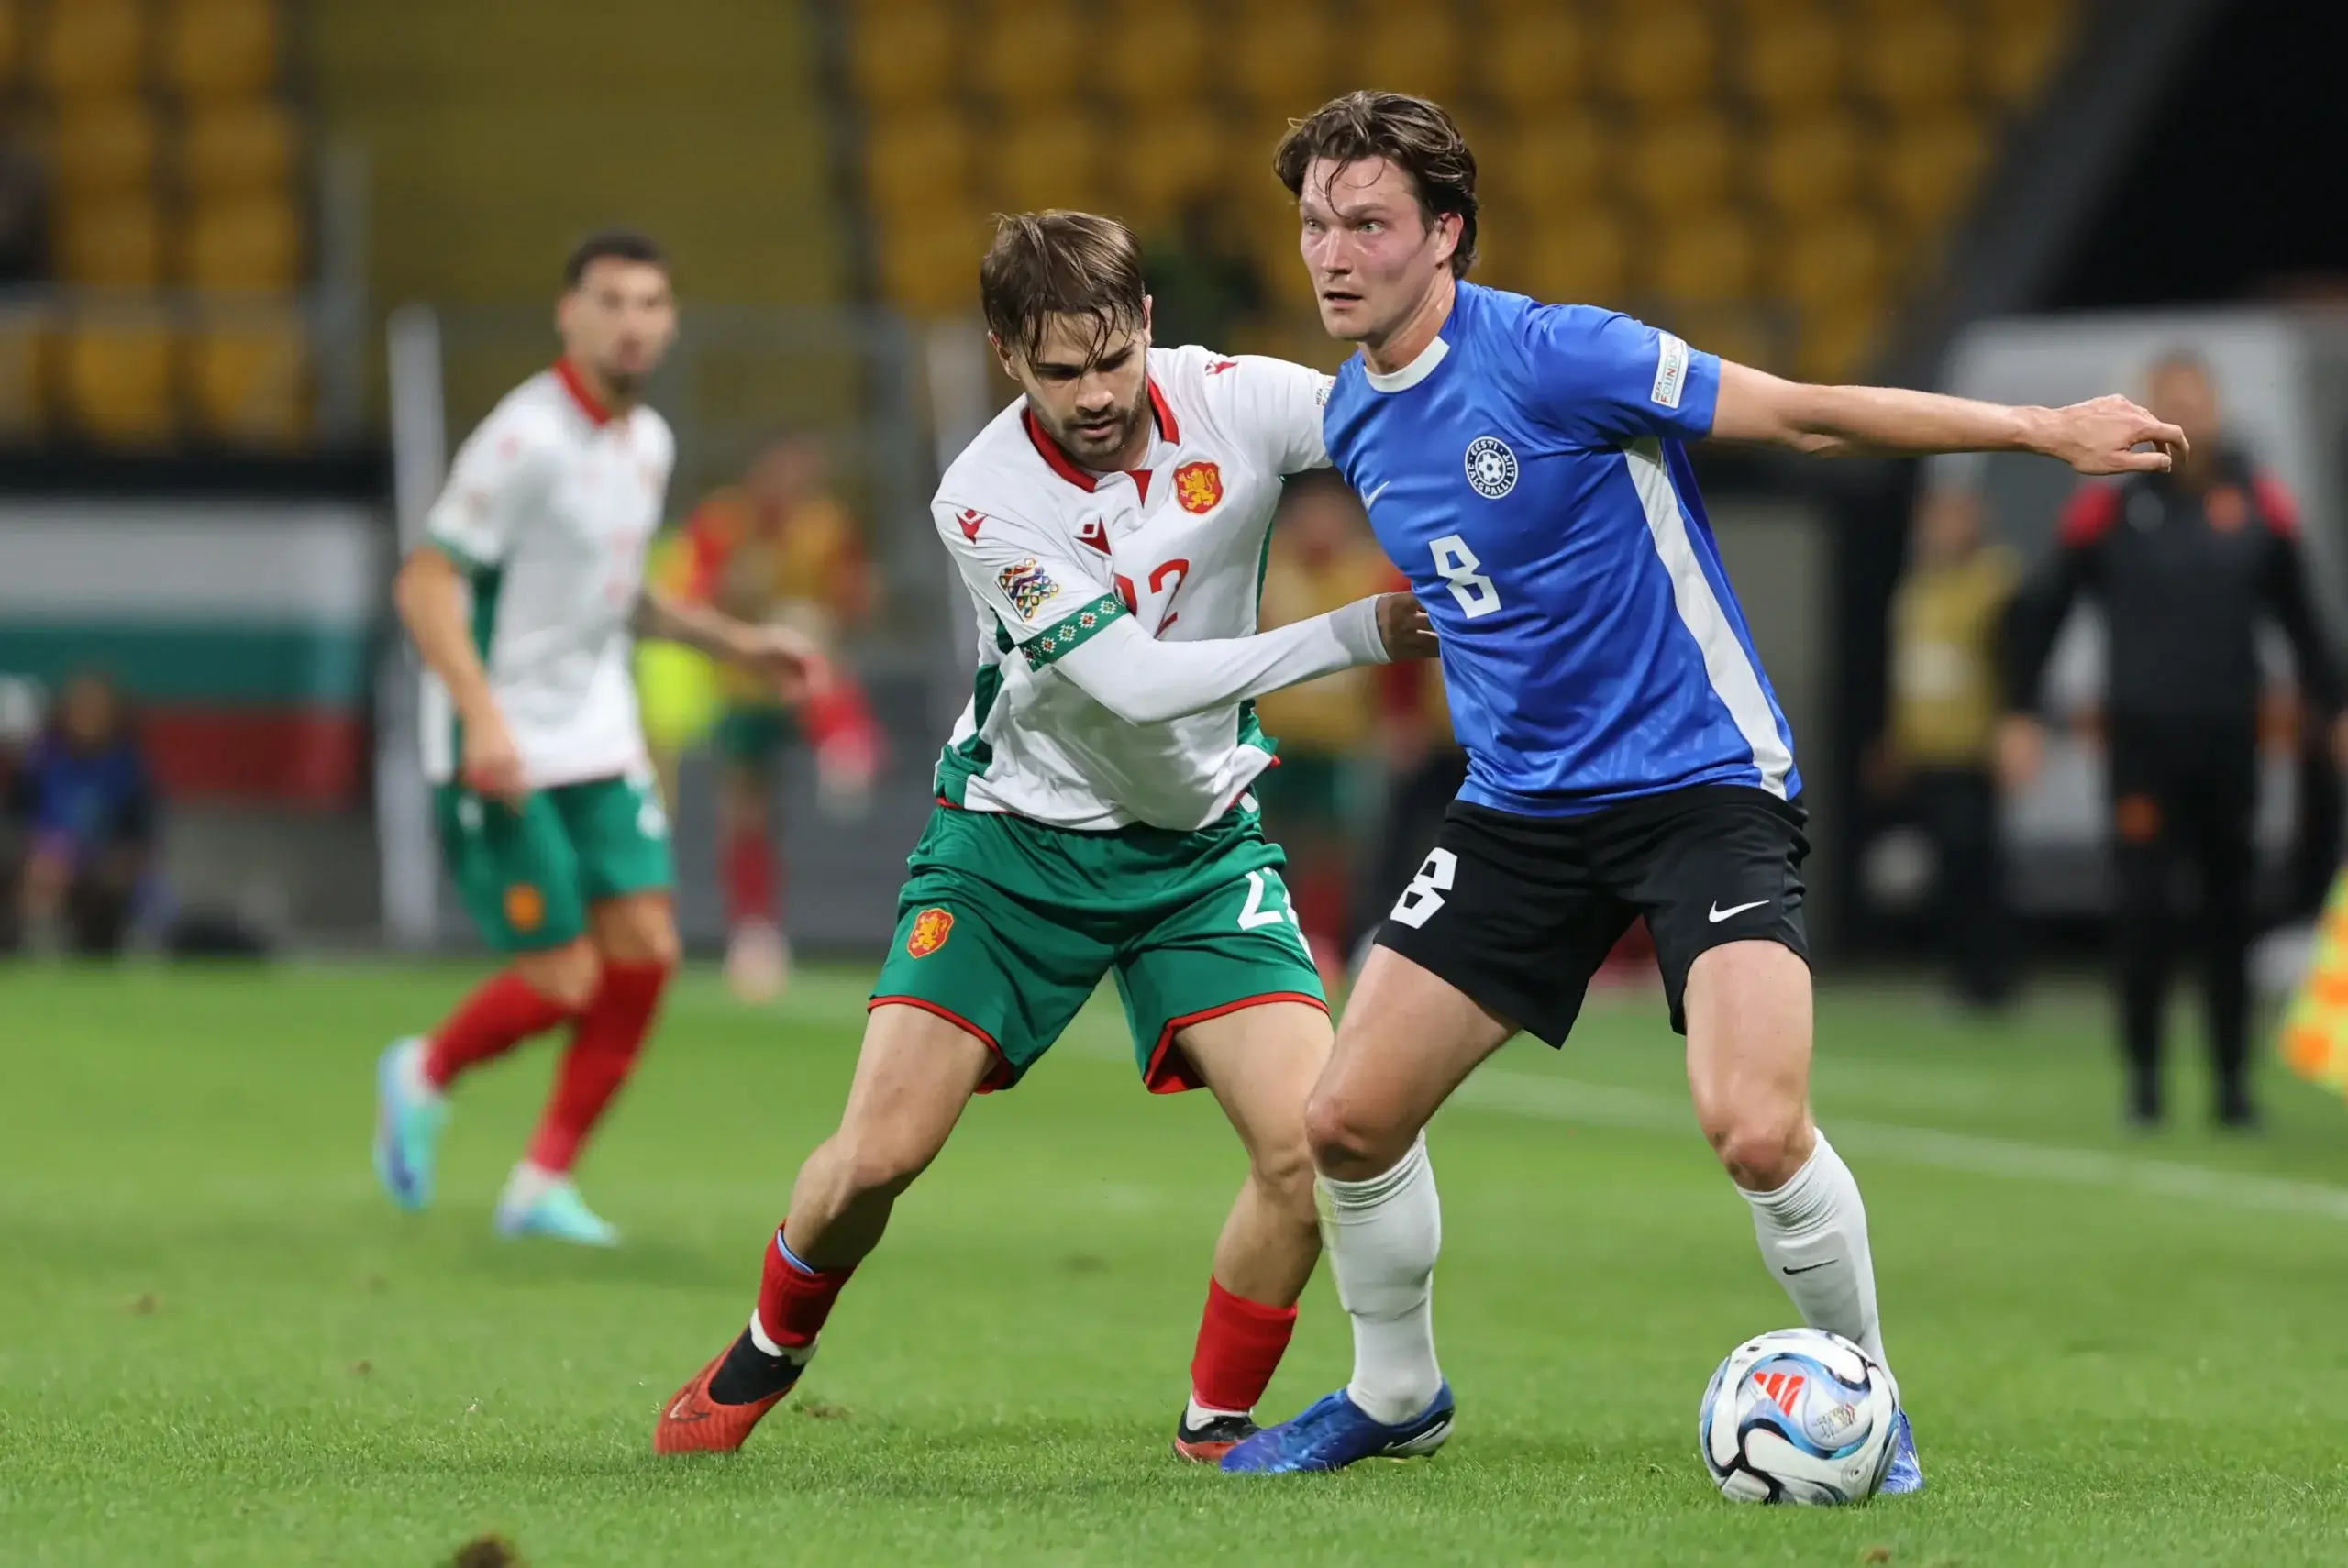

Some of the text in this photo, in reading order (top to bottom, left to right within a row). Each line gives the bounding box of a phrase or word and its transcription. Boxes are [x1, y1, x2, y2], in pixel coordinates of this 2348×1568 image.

[1470, 440, 1498, 456] EESTI
[1502, 454, 1514, 478] LIIT
[1468, 463, 1512, 495] JALGPALLI
[1428, 534, 1501, 620] 8
[1236, 867, 1301, 932] 2
[1390, 846, 1458, 930] 8
